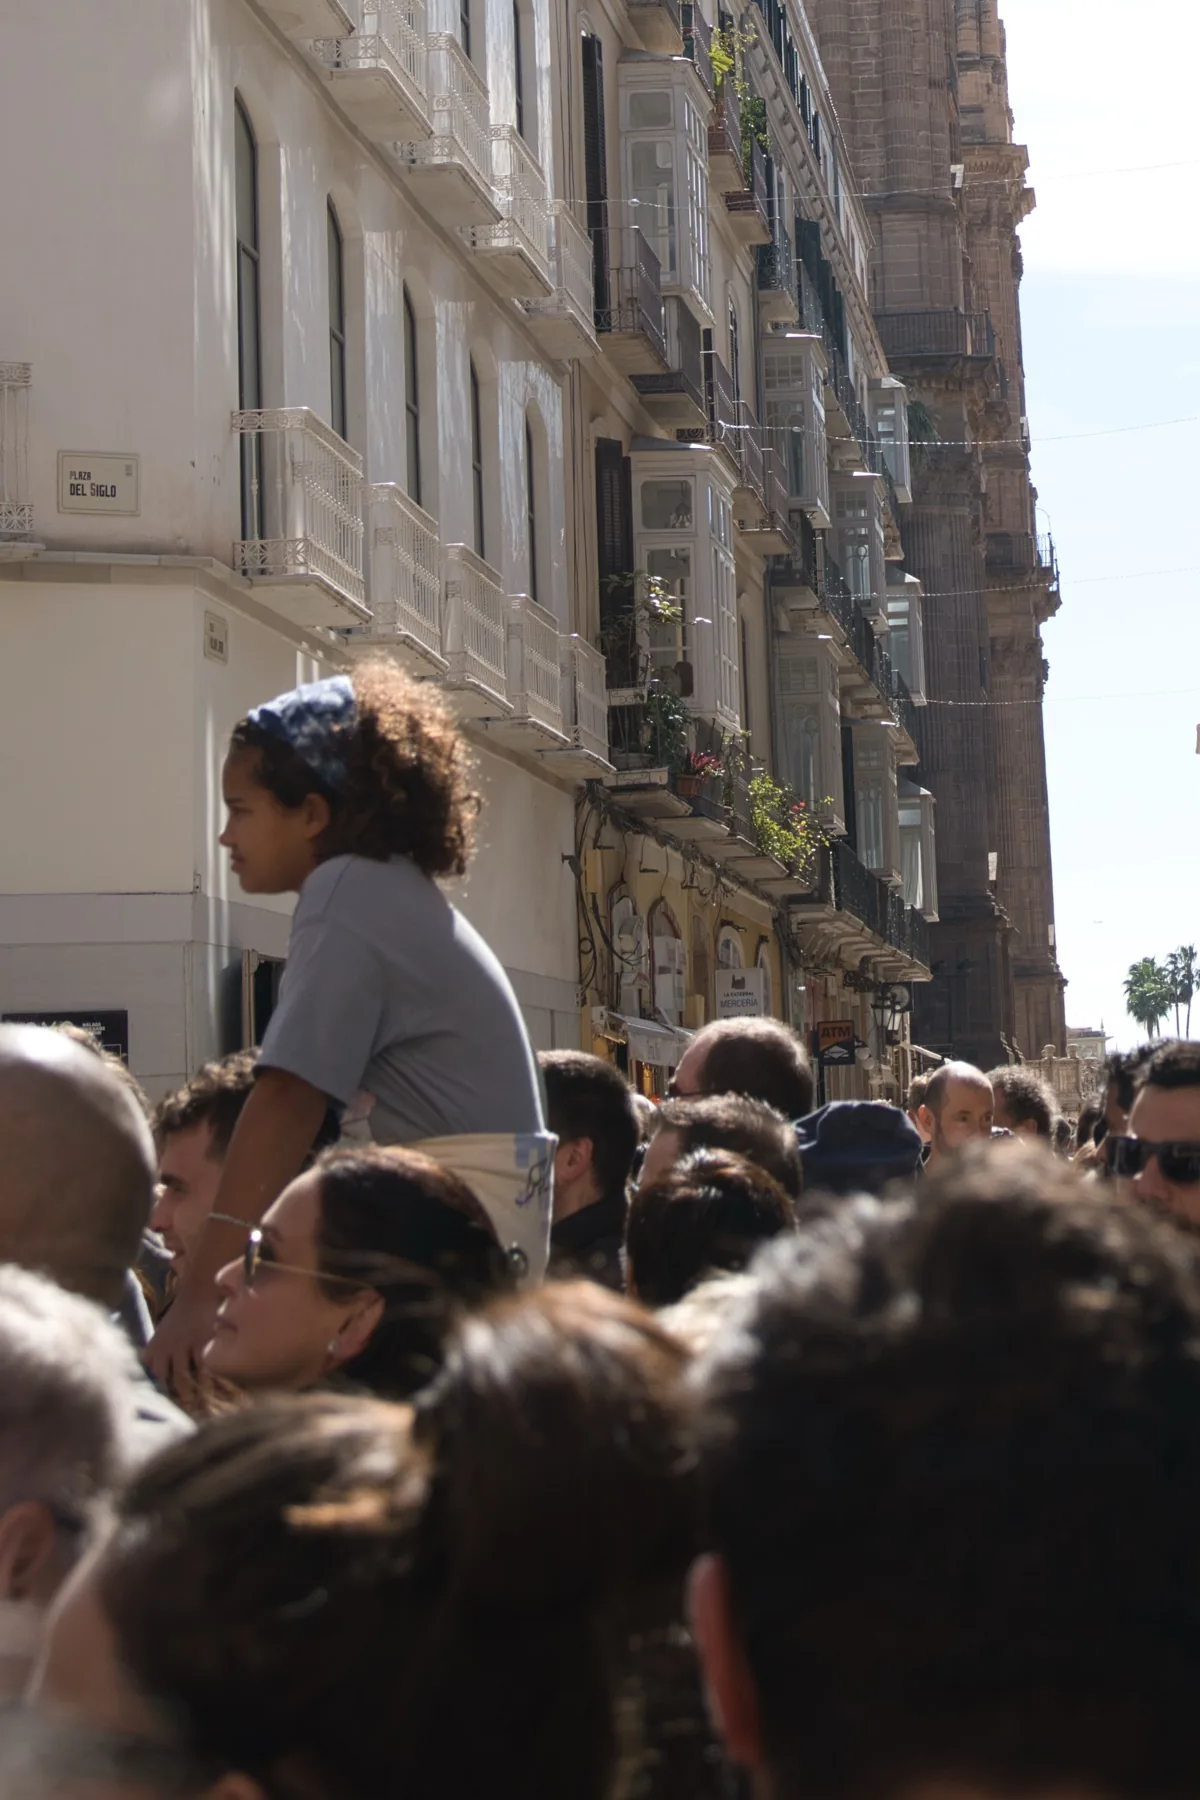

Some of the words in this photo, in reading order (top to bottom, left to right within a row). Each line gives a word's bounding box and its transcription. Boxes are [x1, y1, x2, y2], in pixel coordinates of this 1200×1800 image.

[69, 470, 92, 481] PLAZA
[69, 482, 87, 497] DEL
[821, 1026, 851, 1038] ATM
